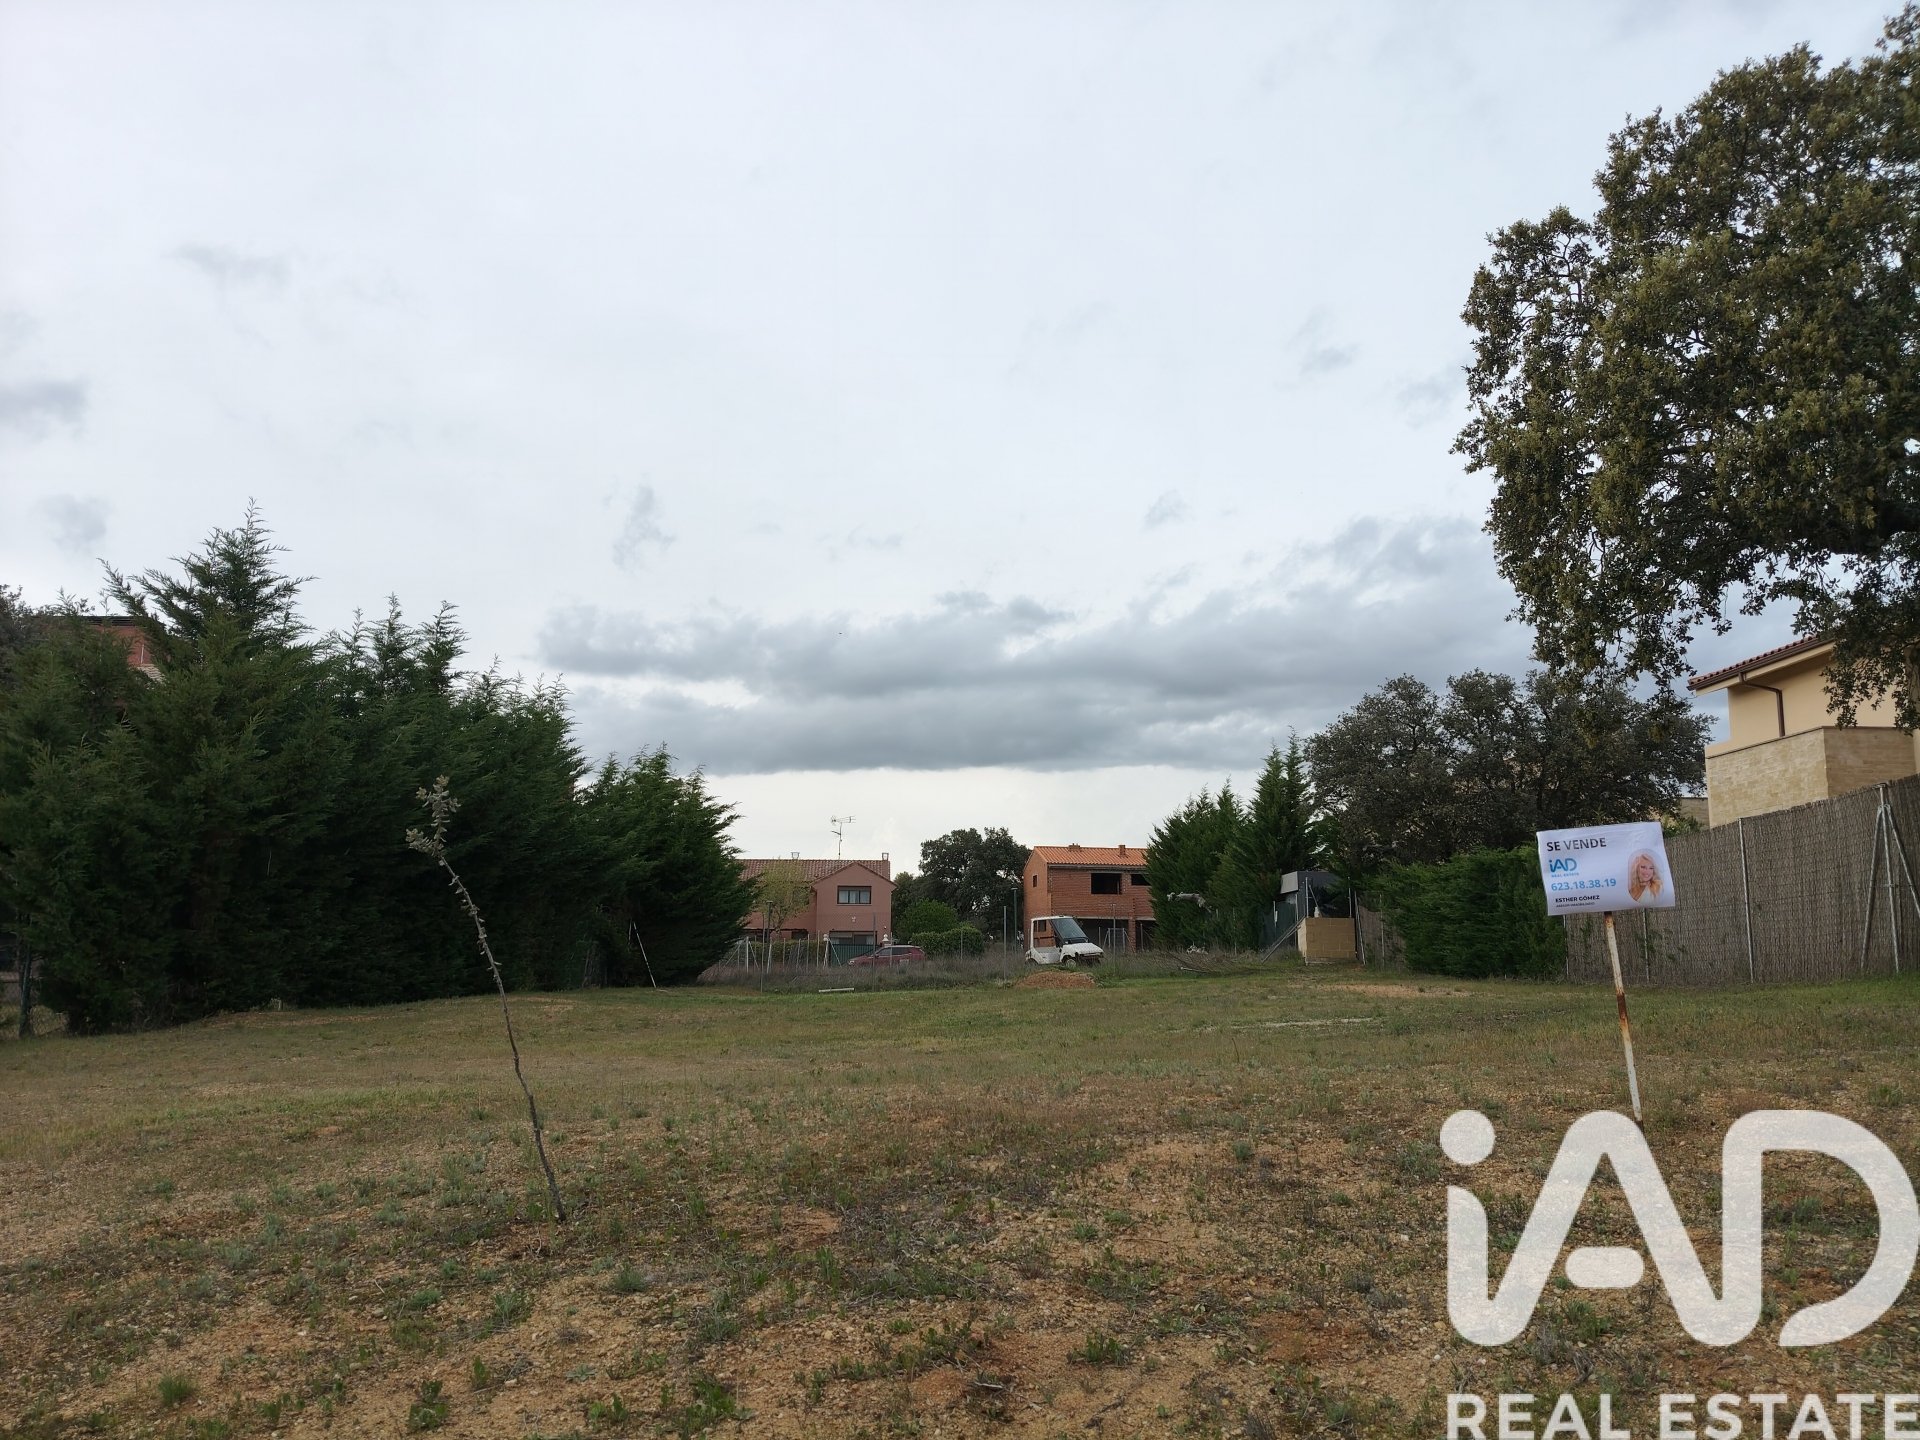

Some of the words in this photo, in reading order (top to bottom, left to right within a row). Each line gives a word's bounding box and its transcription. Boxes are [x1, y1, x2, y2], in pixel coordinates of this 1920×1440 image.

[1547, 841, 1561, 852] SE
[1563, 838, 1607, 850] VENDE
[1551, 878, 1616, 891] 623.18.38.19
